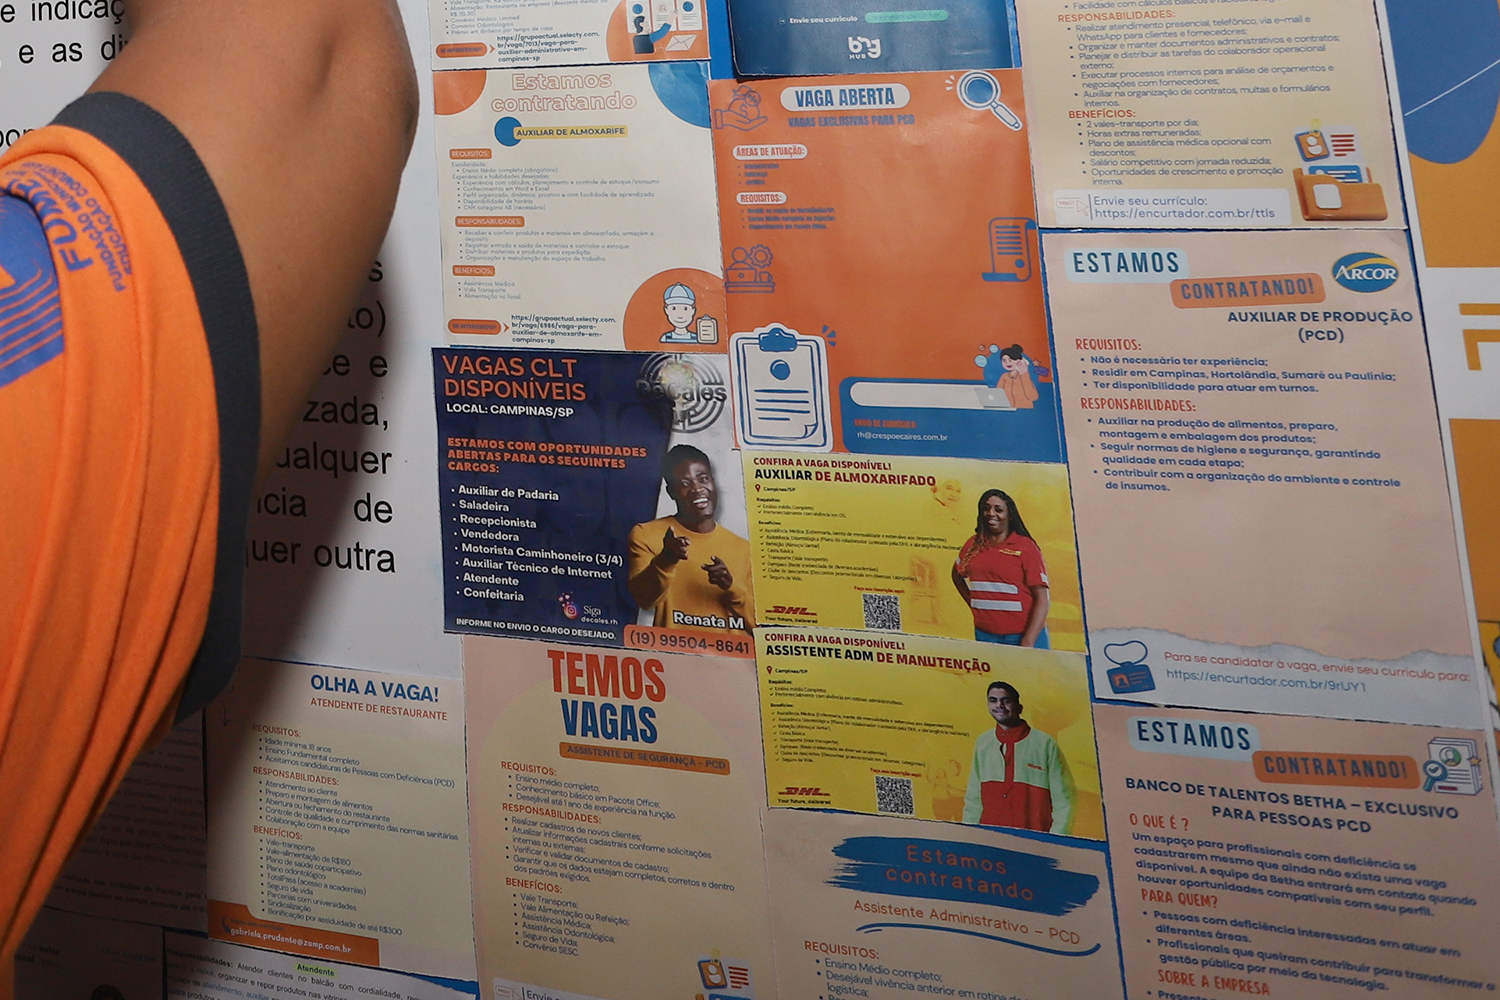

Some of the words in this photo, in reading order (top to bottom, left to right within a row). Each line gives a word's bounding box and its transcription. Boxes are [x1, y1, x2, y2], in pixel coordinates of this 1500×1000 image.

[17, 45, 34, 64] e
[51, 40, 83, 63] as
[795, 89, 833, 107] VAGA
[839, 88, 895, 106] ABERTA
[1073, 252, 1180, 274] ESTAMOS
[1333, 264, 1398, 281] ARCOR
[1181, 278, 1315, 300] CONTRATANDO!
[1227, 311, 1297, 324] AUXILIAR
[1300, 311, 1320, 324] DE
[1322, 309, 1413, 327] PRODUÇÃO
[1075, 338, 1142, 352] REQUISITOS:
[1298, 328, 1345, 344] (PCD)
[442, 355, 526, 376] VAGAS
[530, 358, 578, 378] CLT
[444, 378, 587, 401] DISPONÍVEIS
[446, 403, 488, 414] LOCAL:
[490, 405, 574, 419] CAMPINAS/SP
[1080, 398, 1197, 413] RESPONSABILIDADES:
[755, 469, 812, 483] AUXILIAR
[815, 471, 832, 482] DE
[833, 472, 936, 487] ALMOXARIFADO
[459, 500, 510, 512] Saladeira
[460, 514, 537, 529] Recepcionista
[461, 529, 520, 542] Vendedora
[463, 588, 524, 602] Confeitaria
[673, 611, 725, 628] Renata
[728, 616, 744, 629] M
[629, 629, 656, 647] (19)
[659, 634, 749, 654] 99504-8641
[766, 645, 842, 662] ASSISTENTE
[844, 649, 874, 663] ADM
[876, 652, 894, 664] DE
[896, 652, 991, 676] MANUTENÇÃO
[547, 649, 667, 702] TEMOS
[310, 673, 360, 695] OLHA
[363, 678, 376, 695] A
[379, 682, 440, 703] VAGA!
[310, 698, 364, 712] ATENDENTE
[366, 702, 377, 714] DE
[379, 704, 448, 721] RESTAURANTE
[560, 698, 659, 744] VAGAS
[1136, 720, 1251, 751] ESTAMOS
[1264, 756, 1408, 779] CONTRATANDO!
[1126, 777, 1182, 793] BANCO
[1186, 783, 1205, 796] DE
[1209, 785, 1290, 805] TALENTOS
[1294, 794, 1346, 810] BETHA
[1365, 800, 1459, 819] EXCLUSIVO
[1212, 806, 1255, 822] PARA
[1259, 810, 1334, 828] PESSOAS
[1337, 817, 1371, 833] PCD
[905, 845, 1008, 875] Estamos
[886, 867, 1035, 901] contratando
[853, 899, 924, 922] Assistente
[930, 907, 1029, 936] Administrativo
[1049, 926, 1080, 946] PCD
